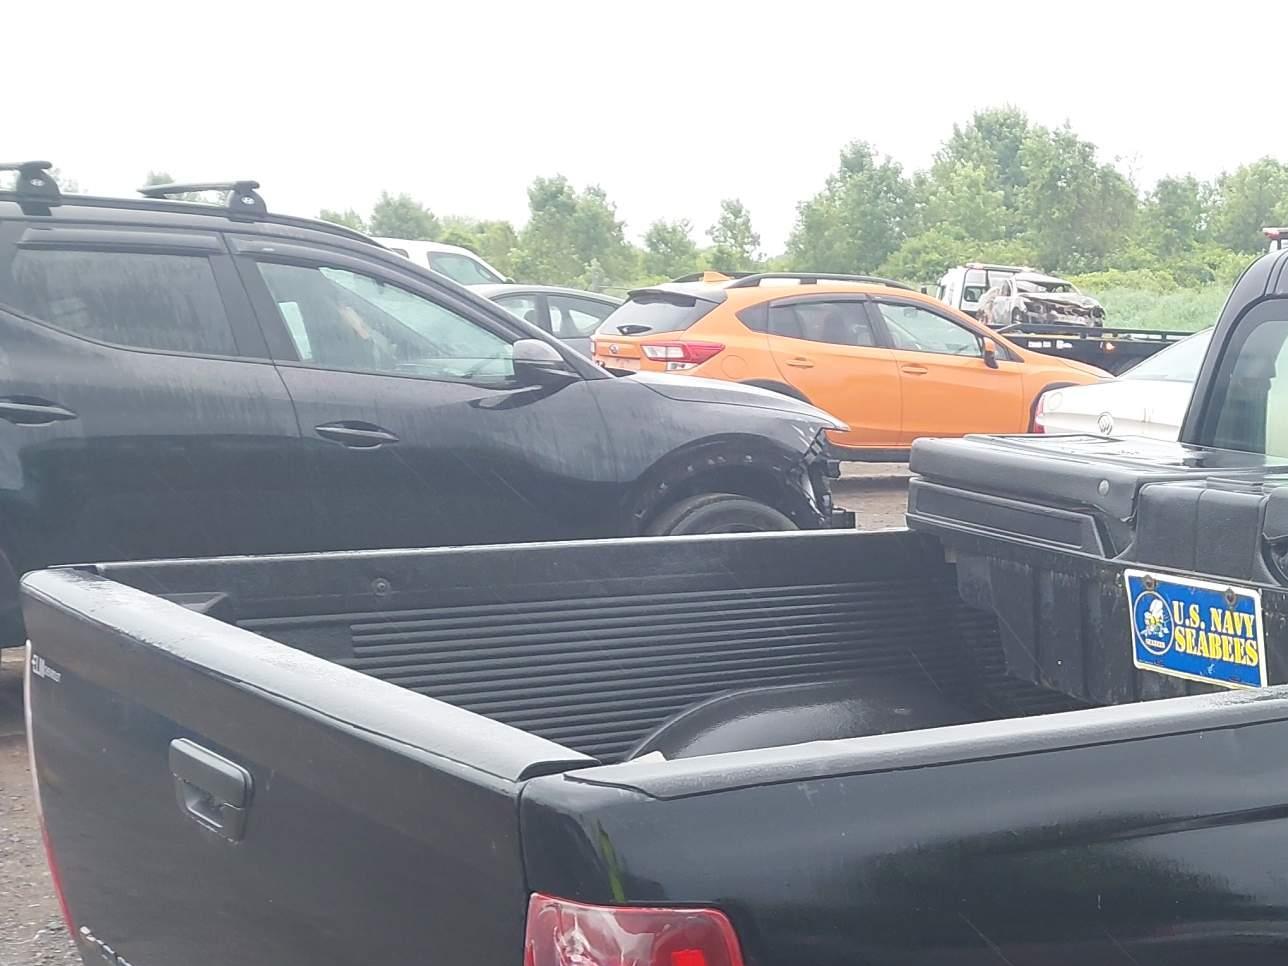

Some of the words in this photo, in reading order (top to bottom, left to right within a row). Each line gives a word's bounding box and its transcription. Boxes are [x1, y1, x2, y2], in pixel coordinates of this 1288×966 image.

[1172, 601, 1206, 630] U.S.
[1210, 607, 1255, 638] NAVY
[1174, 626, 1259, 666] SEABEES
